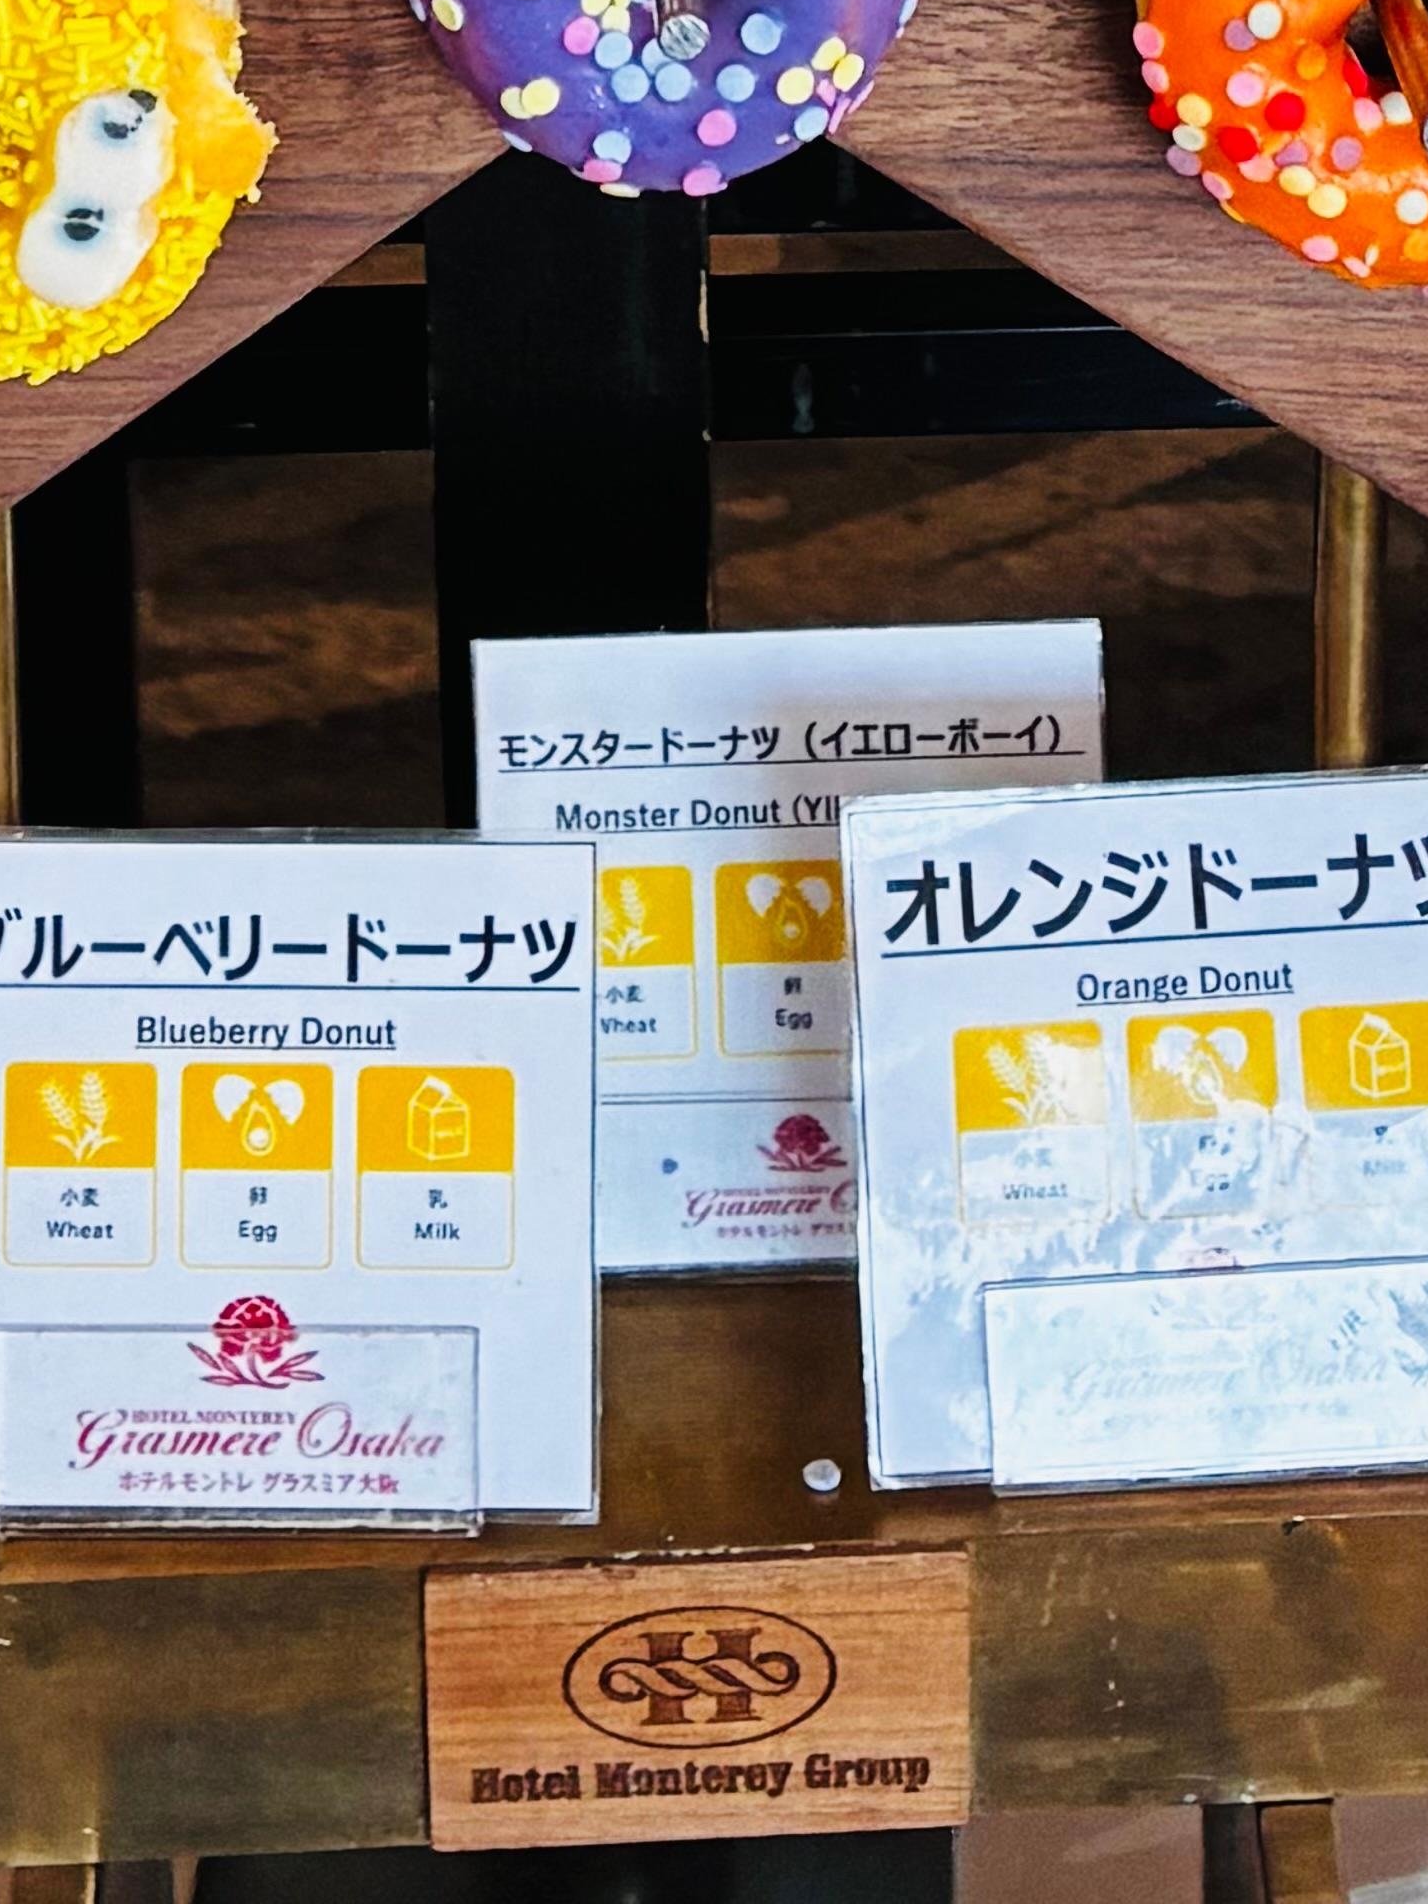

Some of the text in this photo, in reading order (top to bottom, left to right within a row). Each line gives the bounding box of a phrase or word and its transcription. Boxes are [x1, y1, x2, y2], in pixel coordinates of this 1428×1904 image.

[556, 802, 679, 832] Monster
[691, 796, 780, 826] Donut
[1077, 964, 1294, 1005] Orange Donut
[775, 1008, 813, 1030] Egg
[136, 1017, 396, 1050] Blueberry Donut
[46, 1221, 114, 1239] Wheat
[238, 1221, 278, 1242] Egg
[415, 1223, 460, 1240] Milk
[296, 1402, 445, 1458] Osaka
[119, 1472, 253, 1493] ホテルモントレ
[471, 1753, 931, 1804] Hotel Monterey Group
